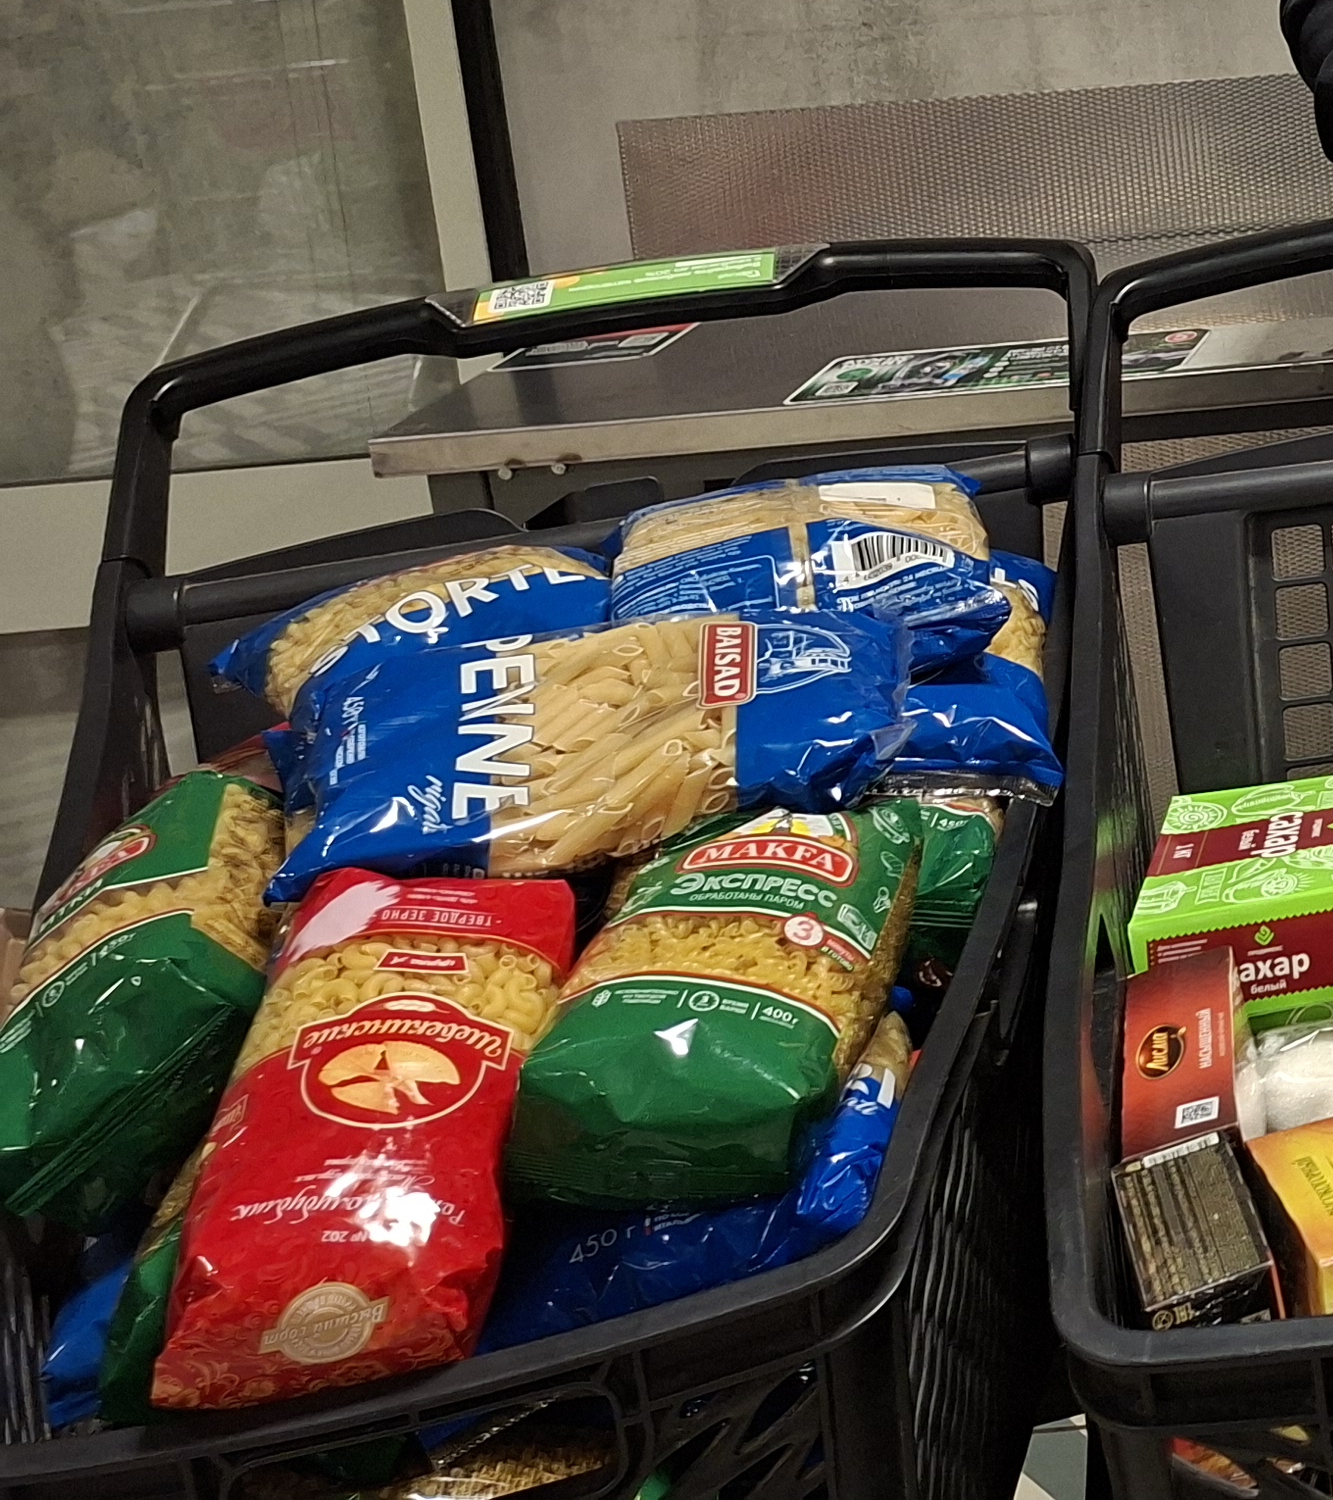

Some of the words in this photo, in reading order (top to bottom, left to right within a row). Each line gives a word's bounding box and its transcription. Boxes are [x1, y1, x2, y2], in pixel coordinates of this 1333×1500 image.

[713, 626, 743, 698] BAISAD
[450, 635, 535, 821] PENNE
[1250, 811, 1306, 858] сахар
[699, 840, 836, 873] MAKFA
[381, 909, 427, 924] ЗЕРНО
[688, 890, 765, 903] ОБРАБОТАНЫ
[764, 893, 806, 911] ПАРОМ
[433, 911, 492, 927] ТВЕРДОЕ
[792, 920, 814, 942] 3
[1240, 951, 1310, 984] ахар
[1250, 979, 1287, 995] белый
[302, 1019, 504, 1058] Шебекинские
[230, 1185, 373, 1224] олубублик
[320, 1229, 348, 1243] 202
[569, 1227, 617, 1267] 450
[261, 1318, 311, 1349] сорт
[313, 1298, 390, 1336] Высший
